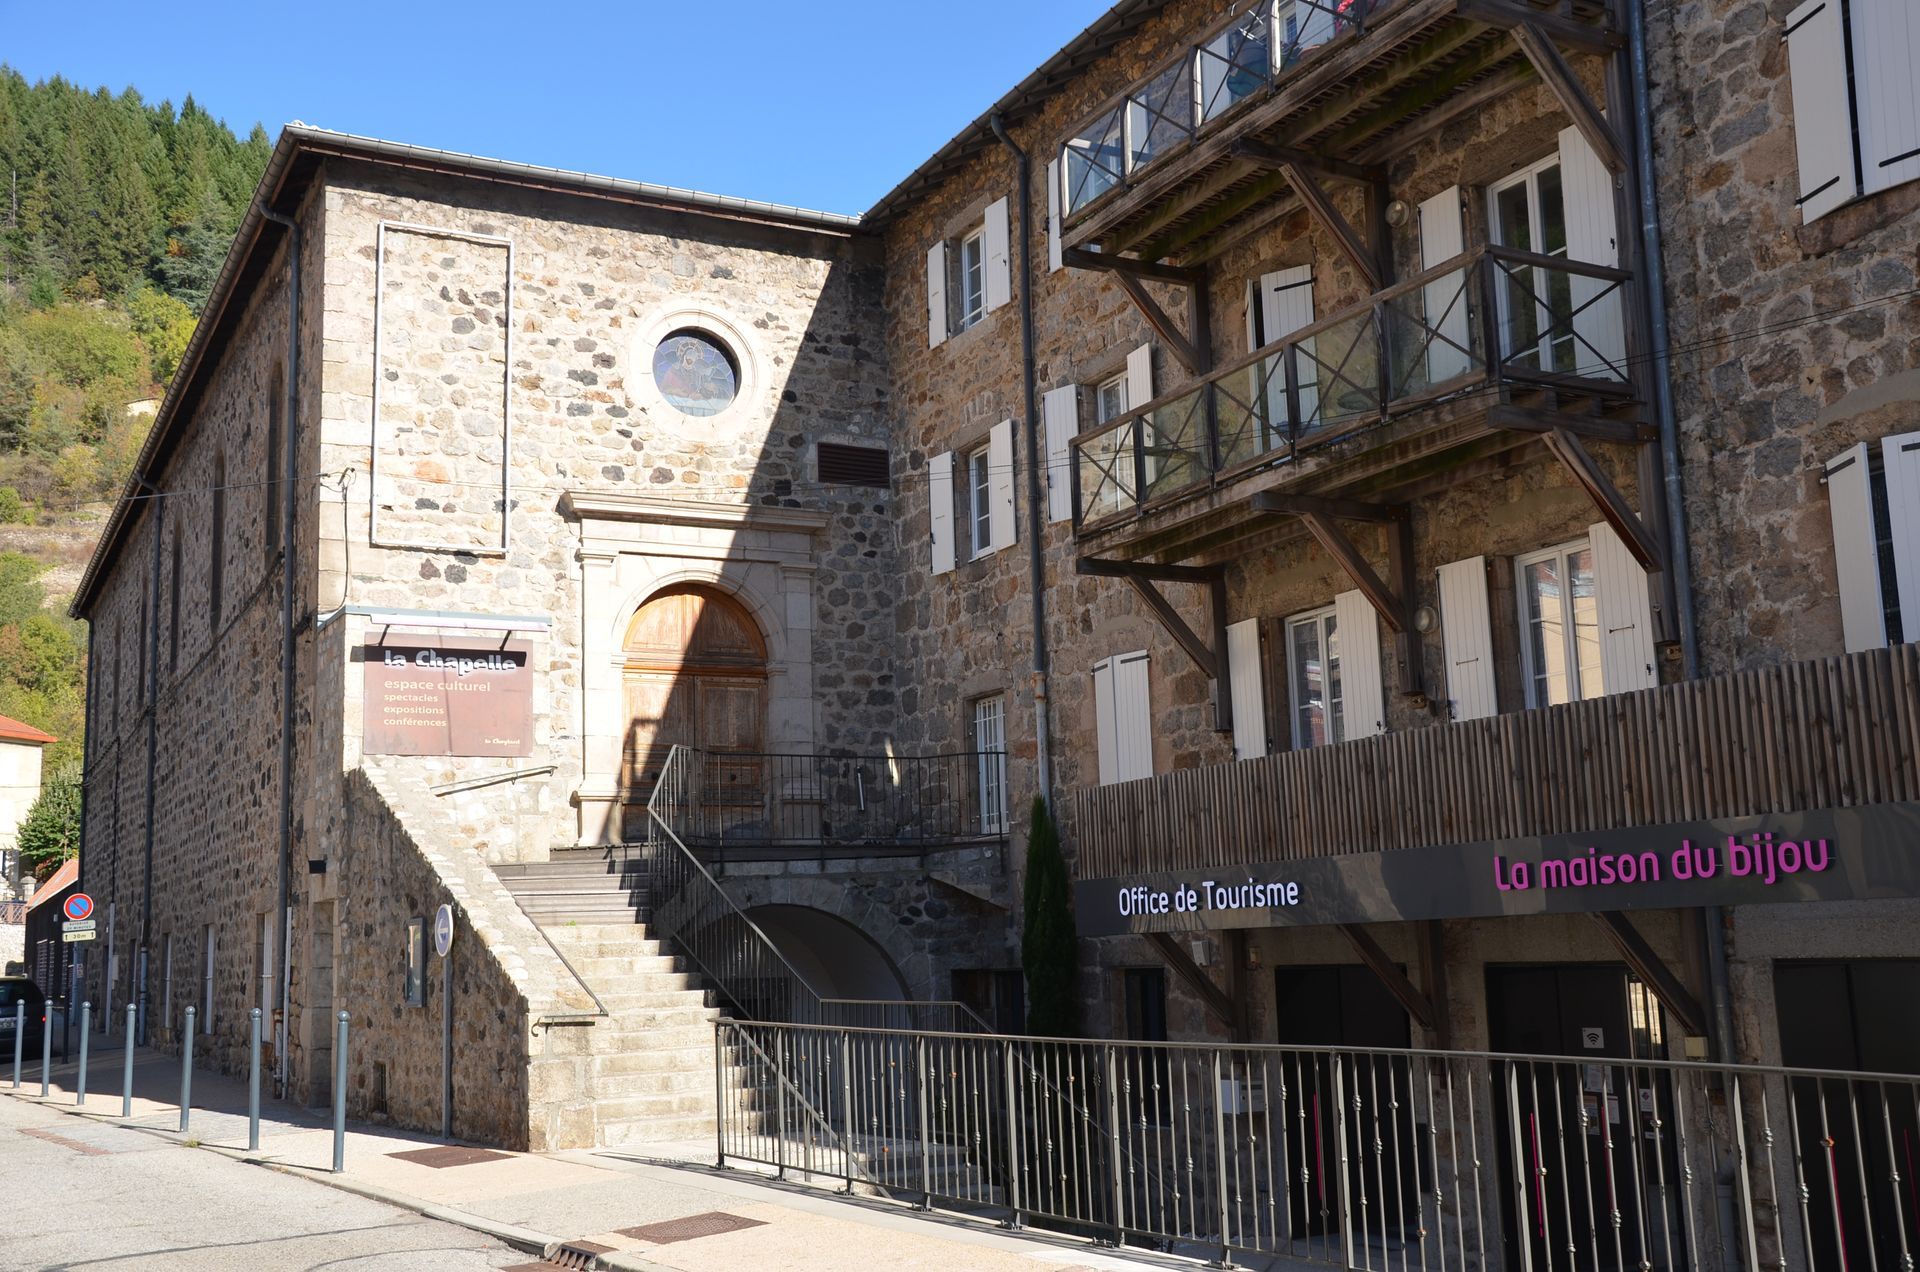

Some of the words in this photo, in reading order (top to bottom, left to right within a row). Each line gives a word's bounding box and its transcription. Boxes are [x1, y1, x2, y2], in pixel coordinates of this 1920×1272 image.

[384, 650, 406, 666] la
[415, 649, 516, 676] Chapelle
[384, 680, 434, 691] espace
[437, 681, 490, 692] culturel
[384, 694, 439, 702] spectacles
[383, 706, 445, 715] expositions
[383, 718, 447, 727] conférences
[1541, 847, 1660, 889] maison
[1671, 839, 1716, 880] du
[1728, 832, 1828, 885] bijou
[1118, 887, 1169, 916] Office
[1174, 883, 1197, 912] de
[1202, 877, 1299, 911] Tourisme
